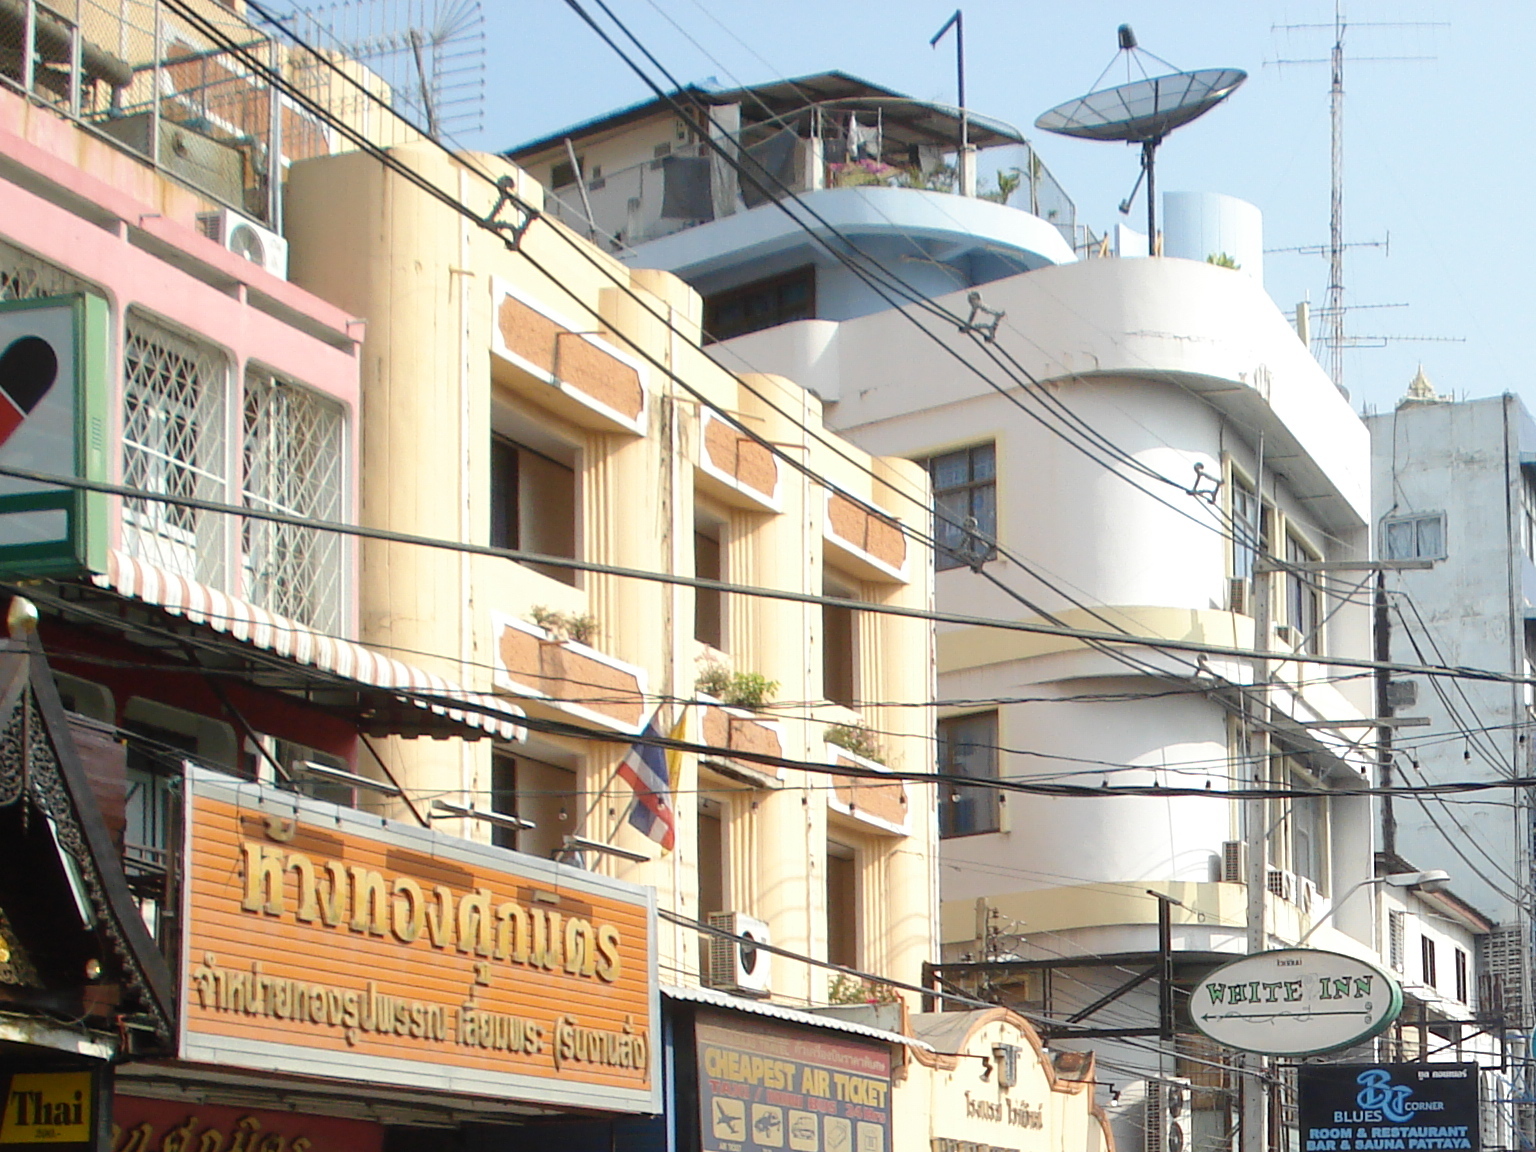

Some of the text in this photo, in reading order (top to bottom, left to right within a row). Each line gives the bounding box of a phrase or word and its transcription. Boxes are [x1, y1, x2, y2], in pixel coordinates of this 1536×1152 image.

[1206, 974, 1374, 1006] WHITE INN
[704, 1046, 889, 1109] CHEAPEST AIR TICKET
[10, 1090, 84, 1127] Thai
[708, 1079, 751, 1100] TAXI
[807, 1096, 838, 1114] BUS
[1334, 1101, 1445, 1123] BLUES CORNER
[1306, 1137, 1472, 1151] BAR & SAUNA PATTAYA
[1309, 1126, 1469, 1139] ROOM & RESTAURANT
